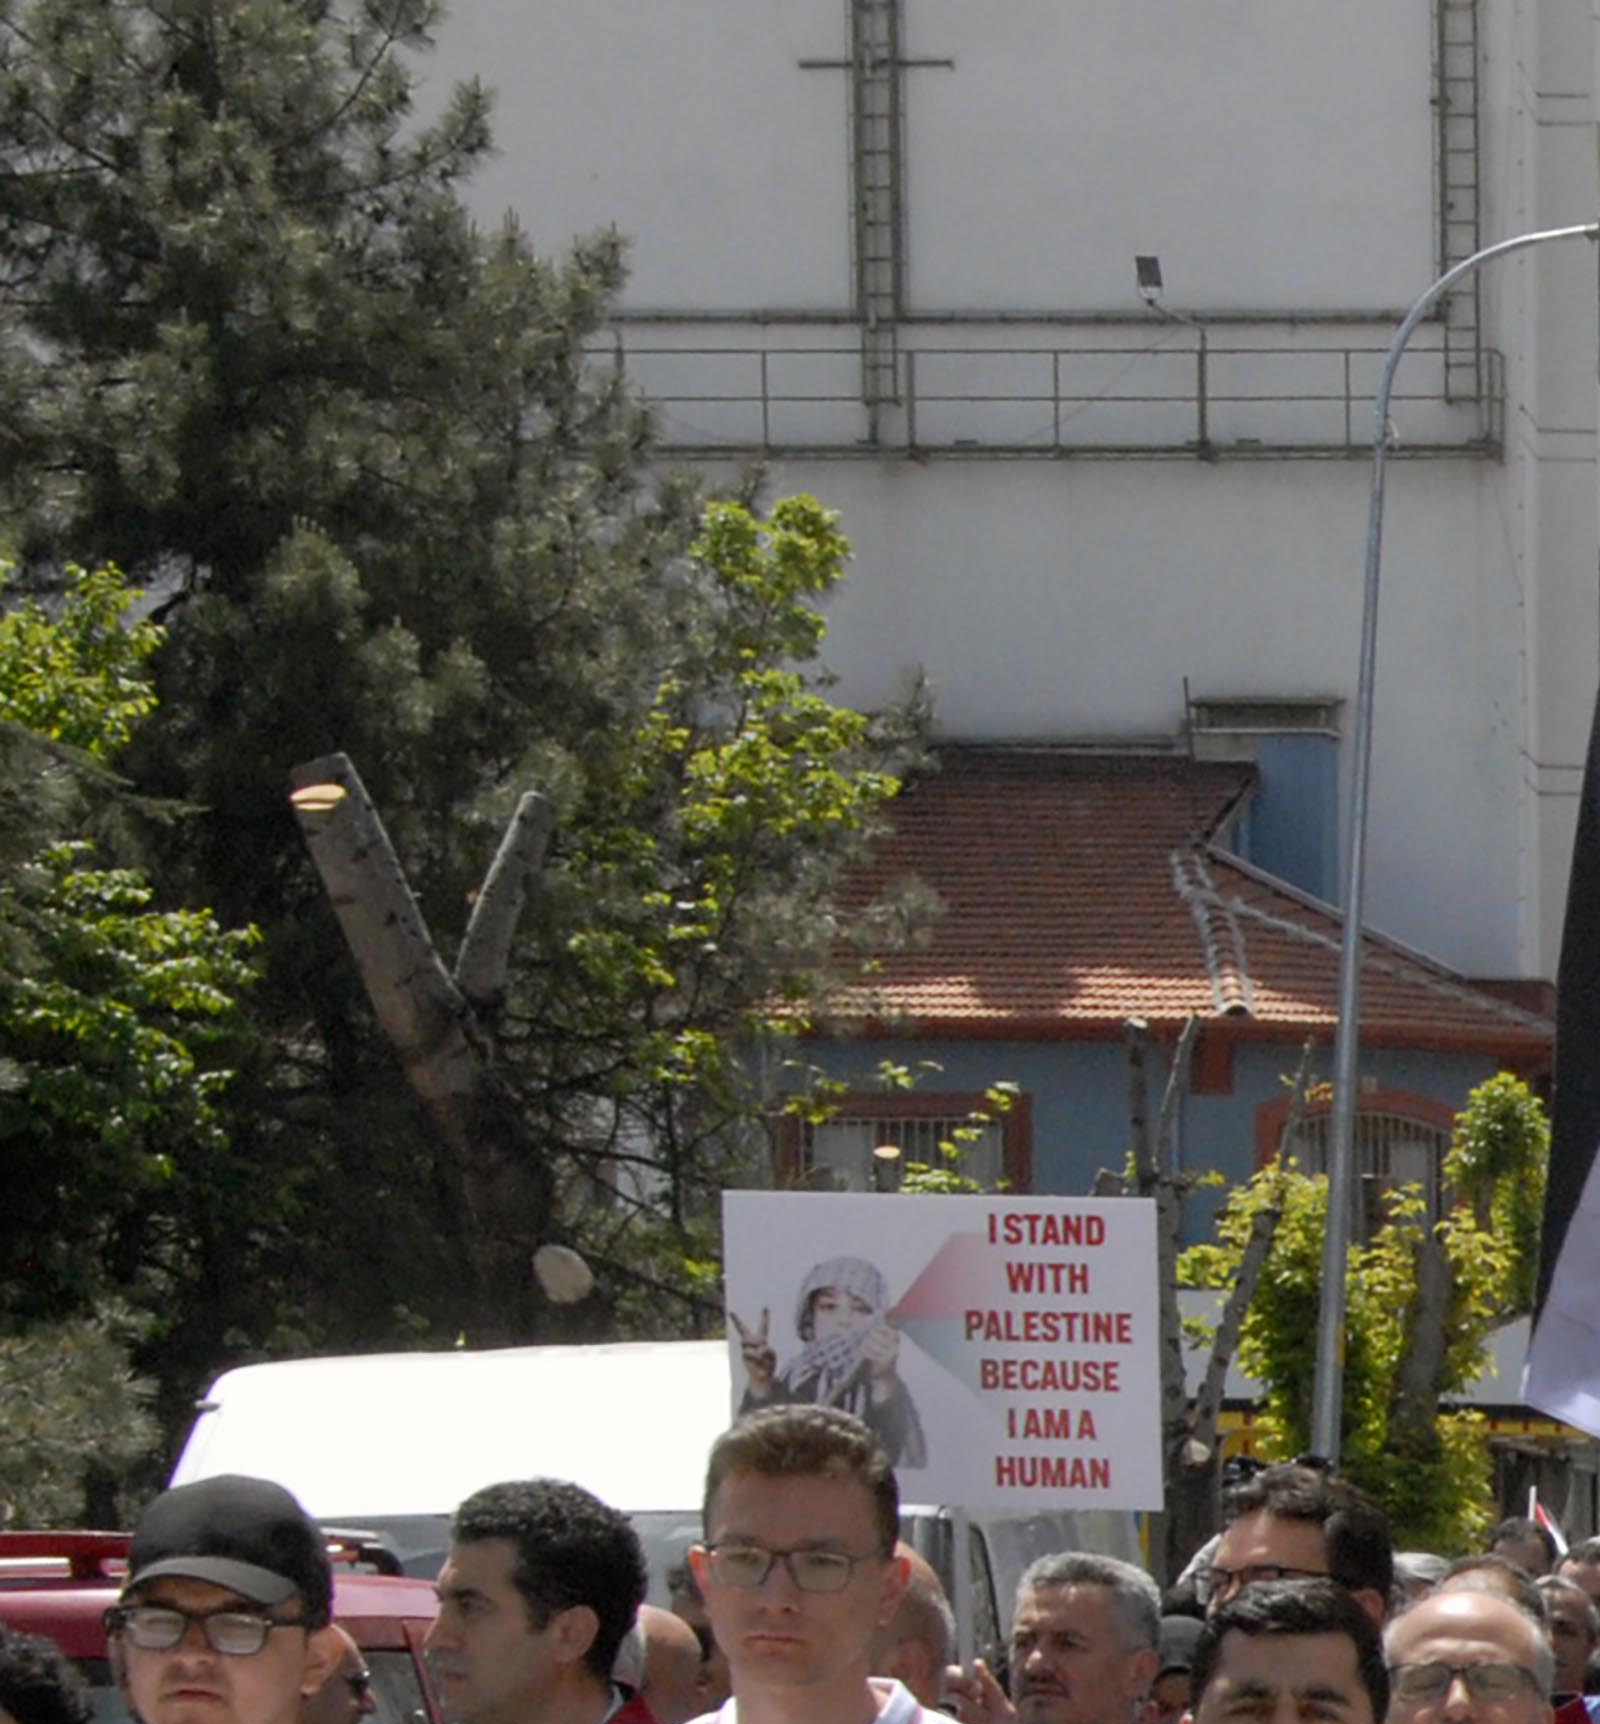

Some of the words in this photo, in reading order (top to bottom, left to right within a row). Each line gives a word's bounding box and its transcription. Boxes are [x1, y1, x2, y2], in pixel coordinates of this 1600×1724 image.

[988, 1213, 997, 1245] I
[1003, 1213, 1106, 1246] STAND
[1005, 1262, 1090, 1294] WITH
[965, 1309, 1132, 1343] PALESTINE
[980, 1358, 1120, 1392] BECAUSE
[1007, 1408, 1016, 1439] I
[1022, 1408, 1070, 1440] AM
[1077, 1409, 1097, 1440] A
[996, 1456, 1111, 1488] HUMAN
